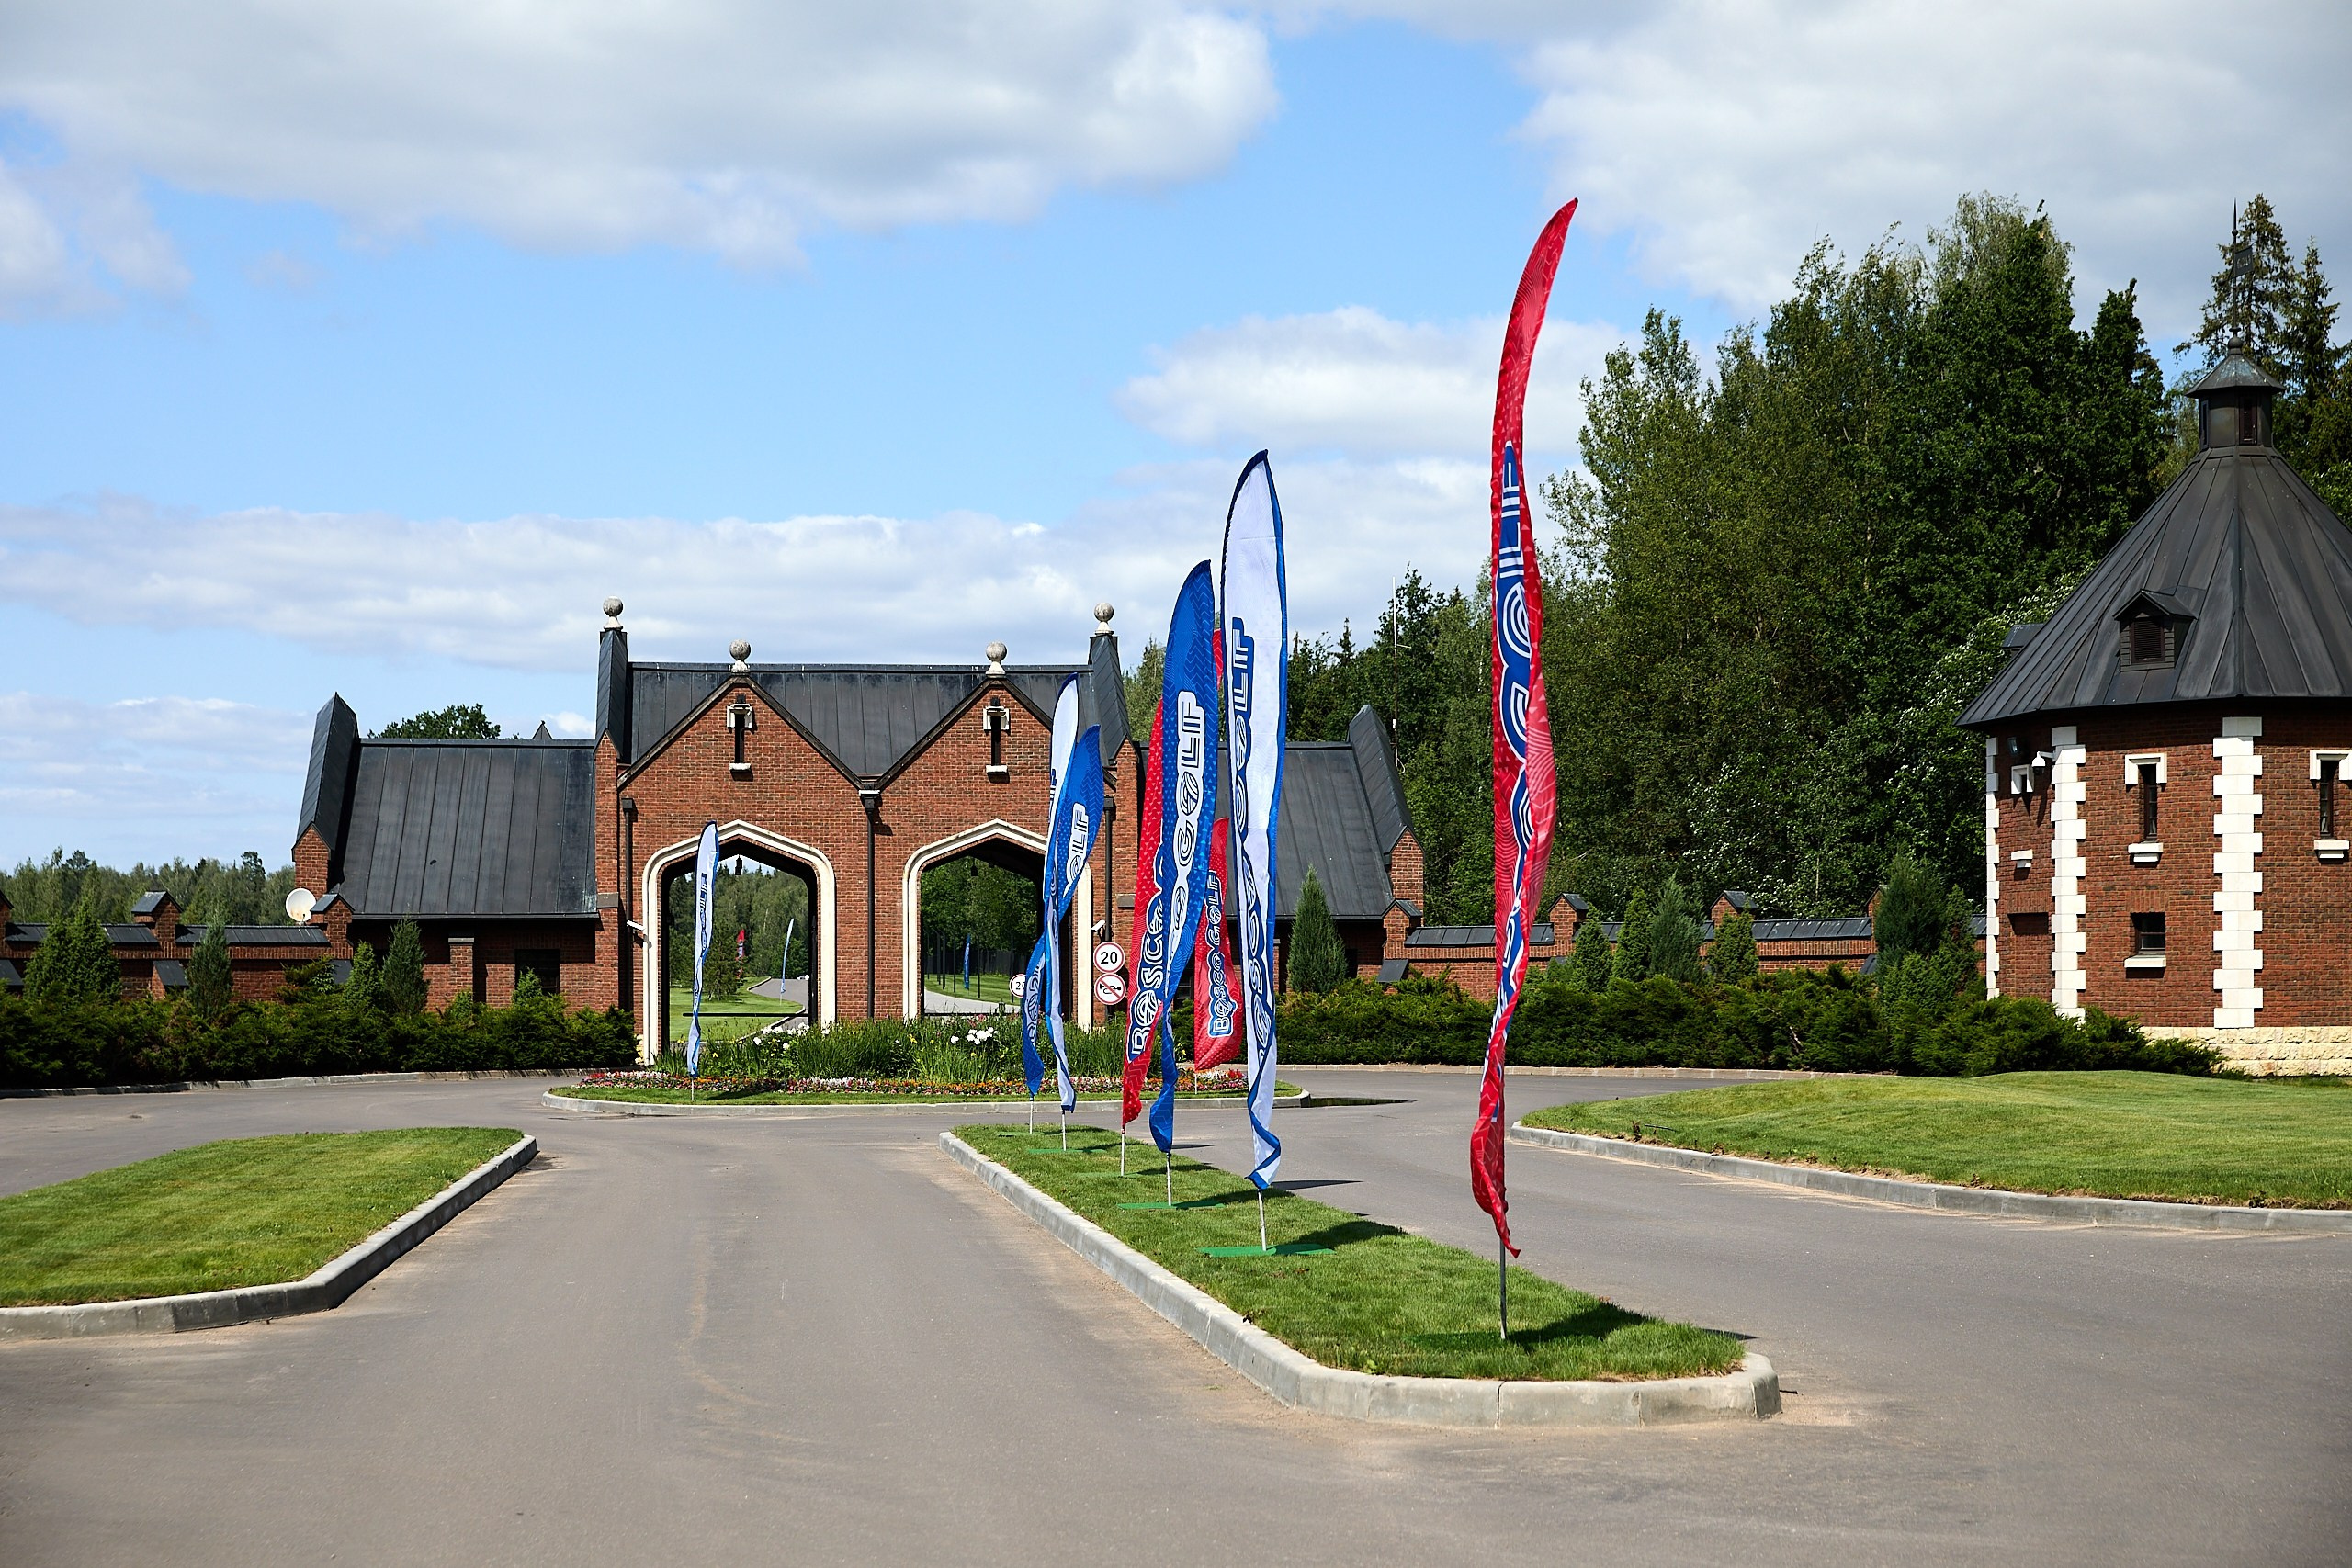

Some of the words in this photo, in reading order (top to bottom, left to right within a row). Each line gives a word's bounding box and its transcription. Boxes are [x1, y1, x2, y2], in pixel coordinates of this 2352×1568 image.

[1178, 701, 1201, 867] GOLF
[1207, 874, 1222, 946] GOLF
[1100, 951, 1118, 964] 20
[1211, 952, 1231, 1032] BOSCO
